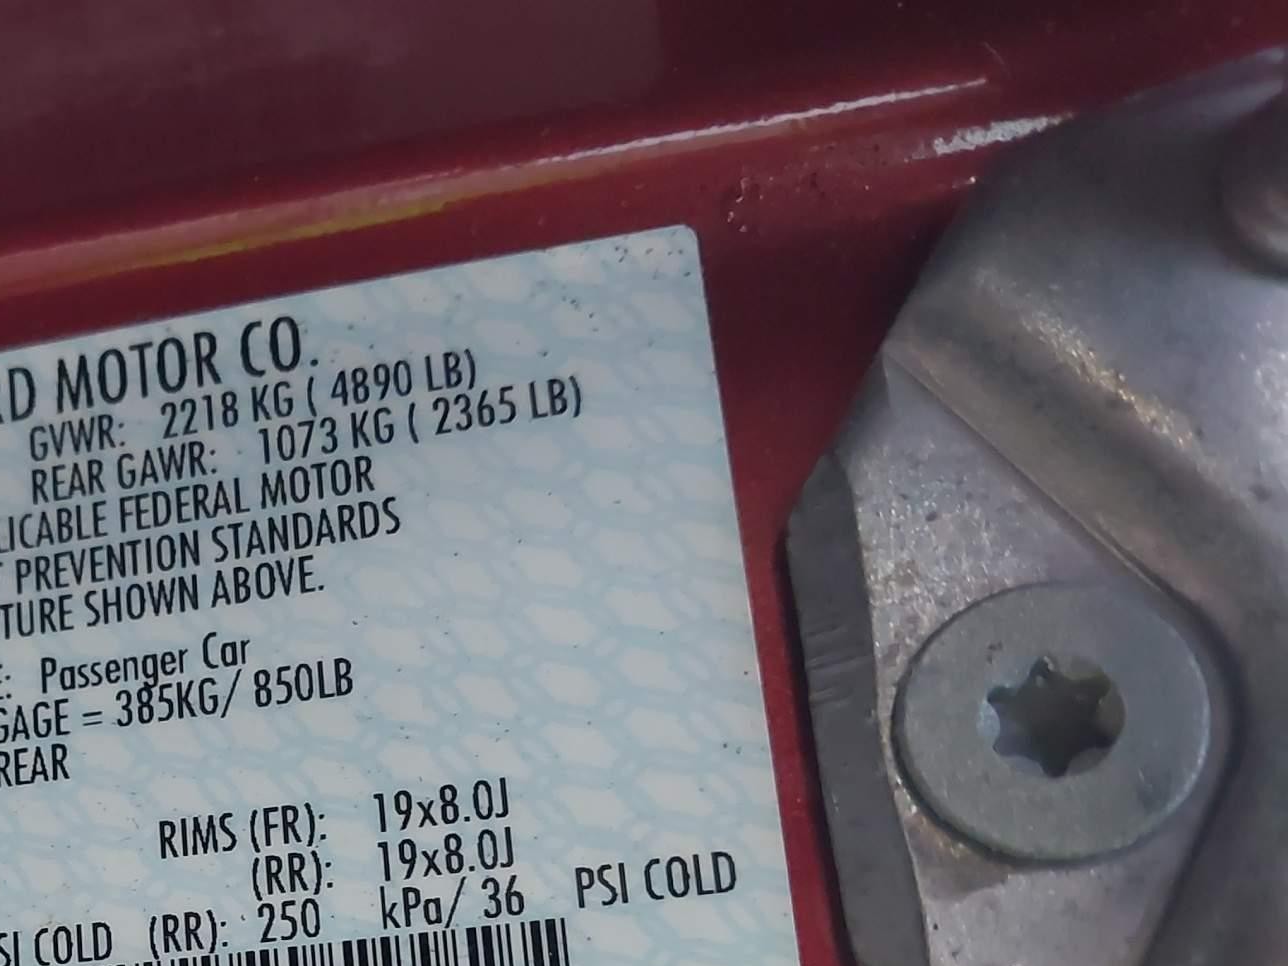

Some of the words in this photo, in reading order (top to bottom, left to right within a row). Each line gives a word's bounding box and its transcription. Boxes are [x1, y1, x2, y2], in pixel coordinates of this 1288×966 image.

[55, 329, 218, 411] MOTOR
[240, 315, 320, 380] CO.
[29, 419, 126, 462] GVWR:
[160, 389, 239, 441] 2218
[252, 379, 294, 424] KG
[330, 359, 413, 407] 4890
[424, 349, 477, 391] LB)
[30, 459, 106, 504] REAR
[116, 444, 218, 491] GAWR:
[258, 416, 339, 467] 1073
[350, 404, 395, 448] KG
[433, 386, 517, 434] 2365
[528, 376, 583, 419] LB)
[118, 476, 251, 533] FEDERAL
[260, 456, 376, 509] MOTOR
[14, 528, 201, 593] PREVENTION
[213, 497, 401, 563] STANDARDS
[84, 577, 200, 628] SHOWN
[211, 554, 326, 609] ABOVE.
[40, 643, 190, 697] Passenger
[202, 632, 251, 666] Car
[253, 657, 355, 709] 850LB
[159, 812, 238, 859] RIMS
[249, 804, 327, 854] (FR):
[374, 777, 509, 834] 19x8.0J
[251, 850, 334, 902] (RR):
[377, 827, 513, 882] 19x8.0J
[34, 921, 114, 966] COLD
[150, 912, 229, 962] (RR):
[257, 898, 321, 943] 250
[481, 876, 526, 919] 36
[576, 863, 630, 910] PSI
[645, 851, 737, 901] COLD
